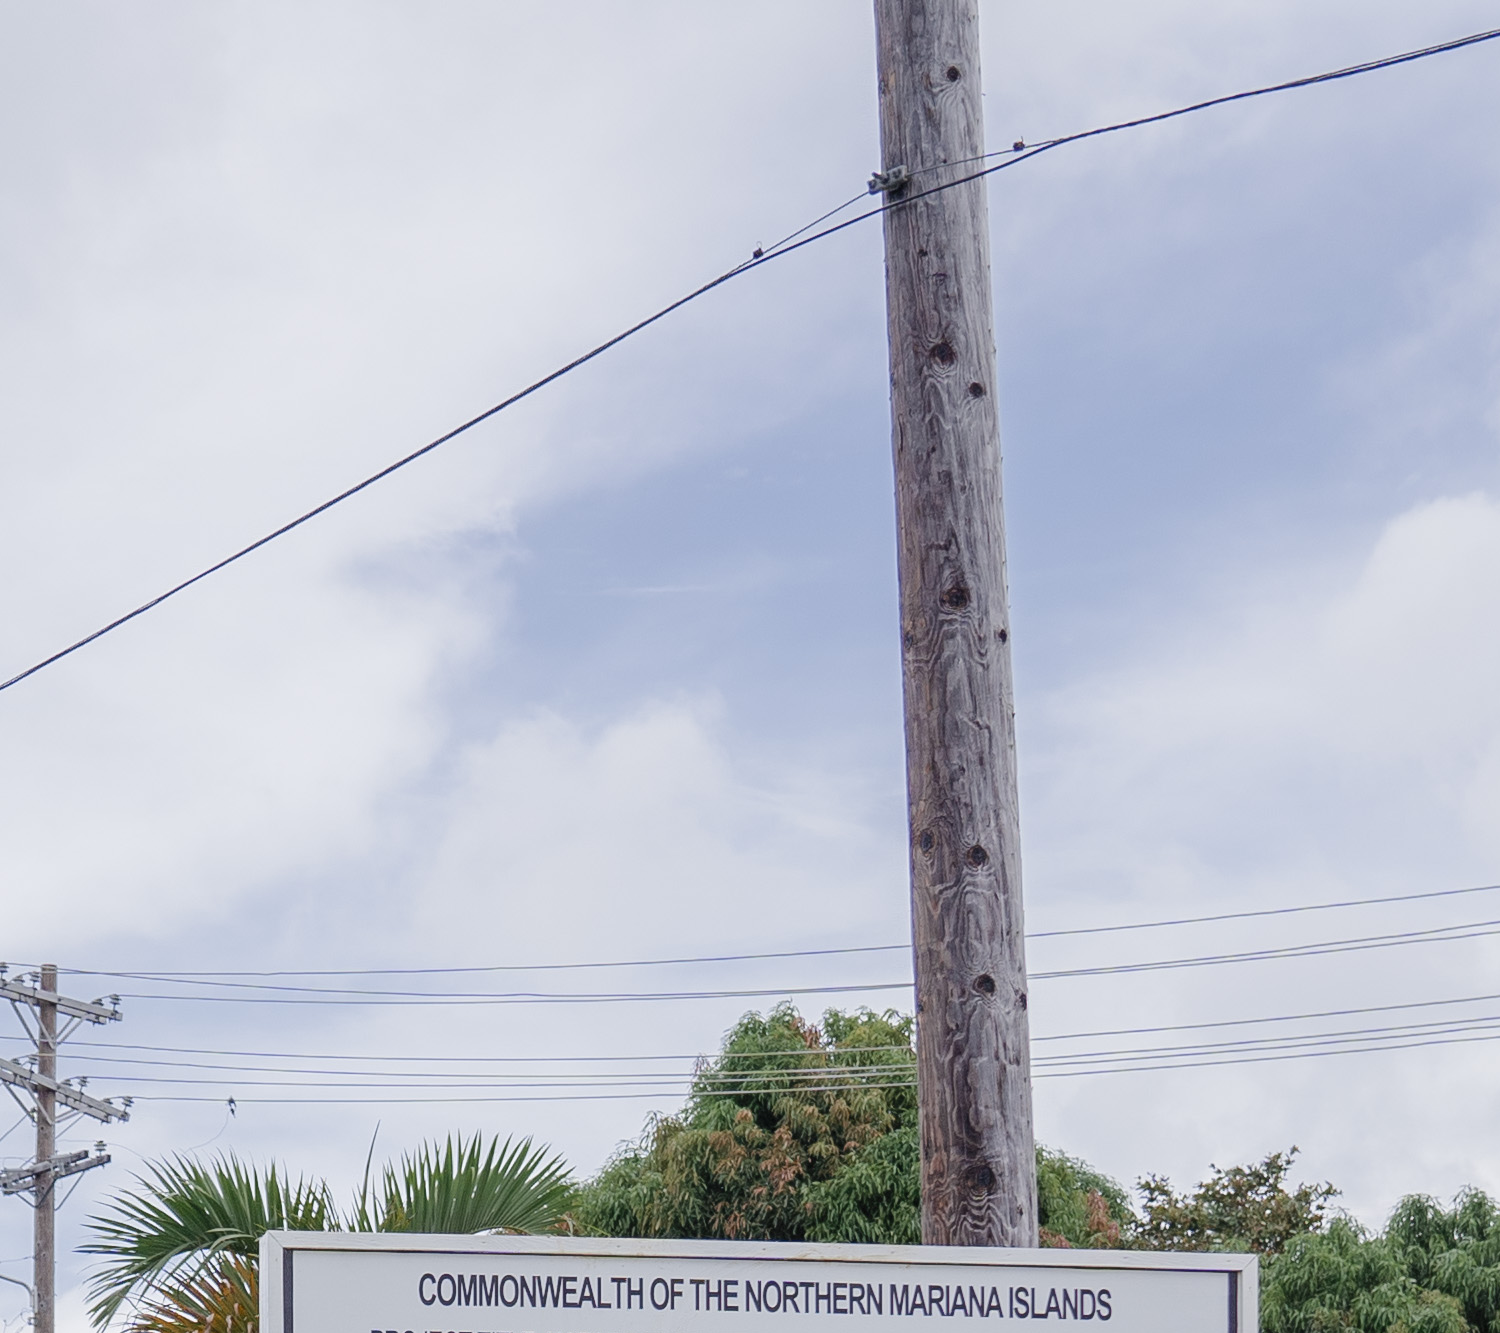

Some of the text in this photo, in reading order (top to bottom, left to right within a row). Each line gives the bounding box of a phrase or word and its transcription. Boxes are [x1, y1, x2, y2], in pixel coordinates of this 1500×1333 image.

[418, 1272, 1113, 1321] COMMONWEALTH OF THE NORTHERN MARIANA ISLANDS
